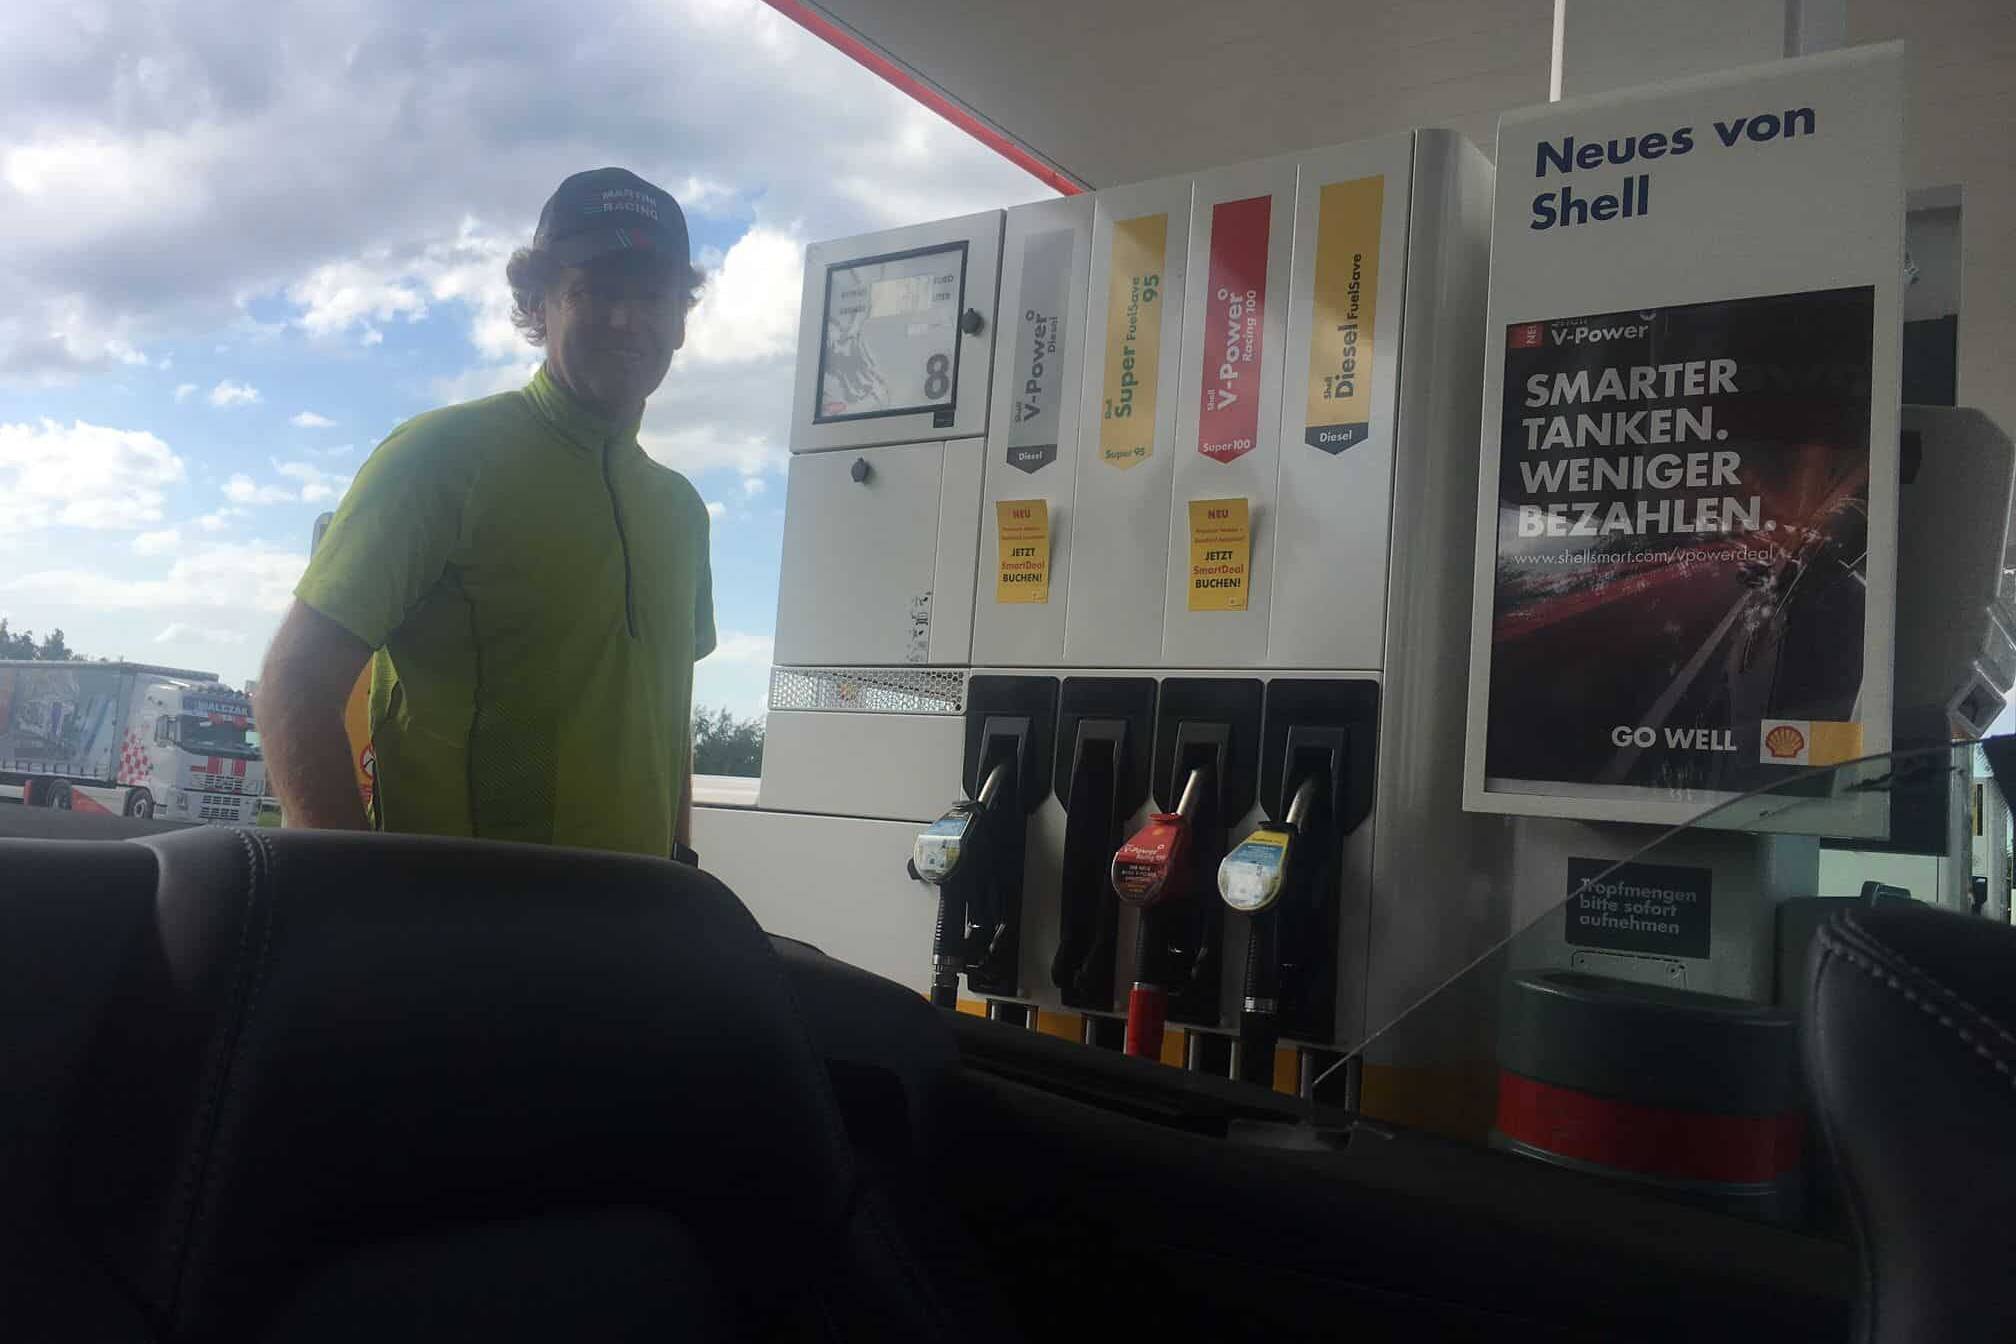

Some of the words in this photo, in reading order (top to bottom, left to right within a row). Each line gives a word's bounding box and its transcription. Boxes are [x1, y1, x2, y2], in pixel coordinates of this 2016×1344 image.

[1535, 126, 1694, 177] Neues
[1713, 106, 1815, 148] von
[1529, 174, 1649, 231] Shell
[1142, 273, 1159, 303] 95
[1245, 289, 1257, 314] 100
[1345, 253, 1362, 321] FuelSave
[1125, 276, 1141, 342] FuelSave
[1048, 316, 1058, 353] Diesel
[1216, 291, 1243, 411] V-Power
[1242, 317, 1257, 362] Racing
[1551, 323, 1648, 346] V-Power
[924, 354, 950, 400] 8
[1022, 314, 1046, 422] V-Power
[1333, 323, 1358, 399] Diesel
[1114, 344, 1138, 418] Super
[1525, 358, 1740, 409] SMARTER
[1319, 429, 1352, 443] Diesel
[1522, 405, 1729, 451] TANKEN.
[1520, 451, 1742, 494] WENIGER
[1517, 495, 1778, 539] BEZAHLEN.
[1001, 559, 1045, 570] SmartDeal
[1011, 546, 1036, 557] JETZT
[1205, 550, 1233, 561] JETZT
[1513, 545, 1775, 567] www.shellsmart.com/vpowerdeal
[1002, 573, 1042, 583] BUCHEN!
[1192, 563, 1244, 575] SmartDeal
[1195, 578, 1241, 590] BUCHEN!
[1611, 726, 1656, 749] GO
[1664, 728, 1737, 752] WELL
[1579, 893, 1617, 913] bitte
[1623, 900, 1679, 918] sofort
[1580, 877, 1697, 904] Tropfmengen
[1579, 913, 1680, 936] aufnehmen
